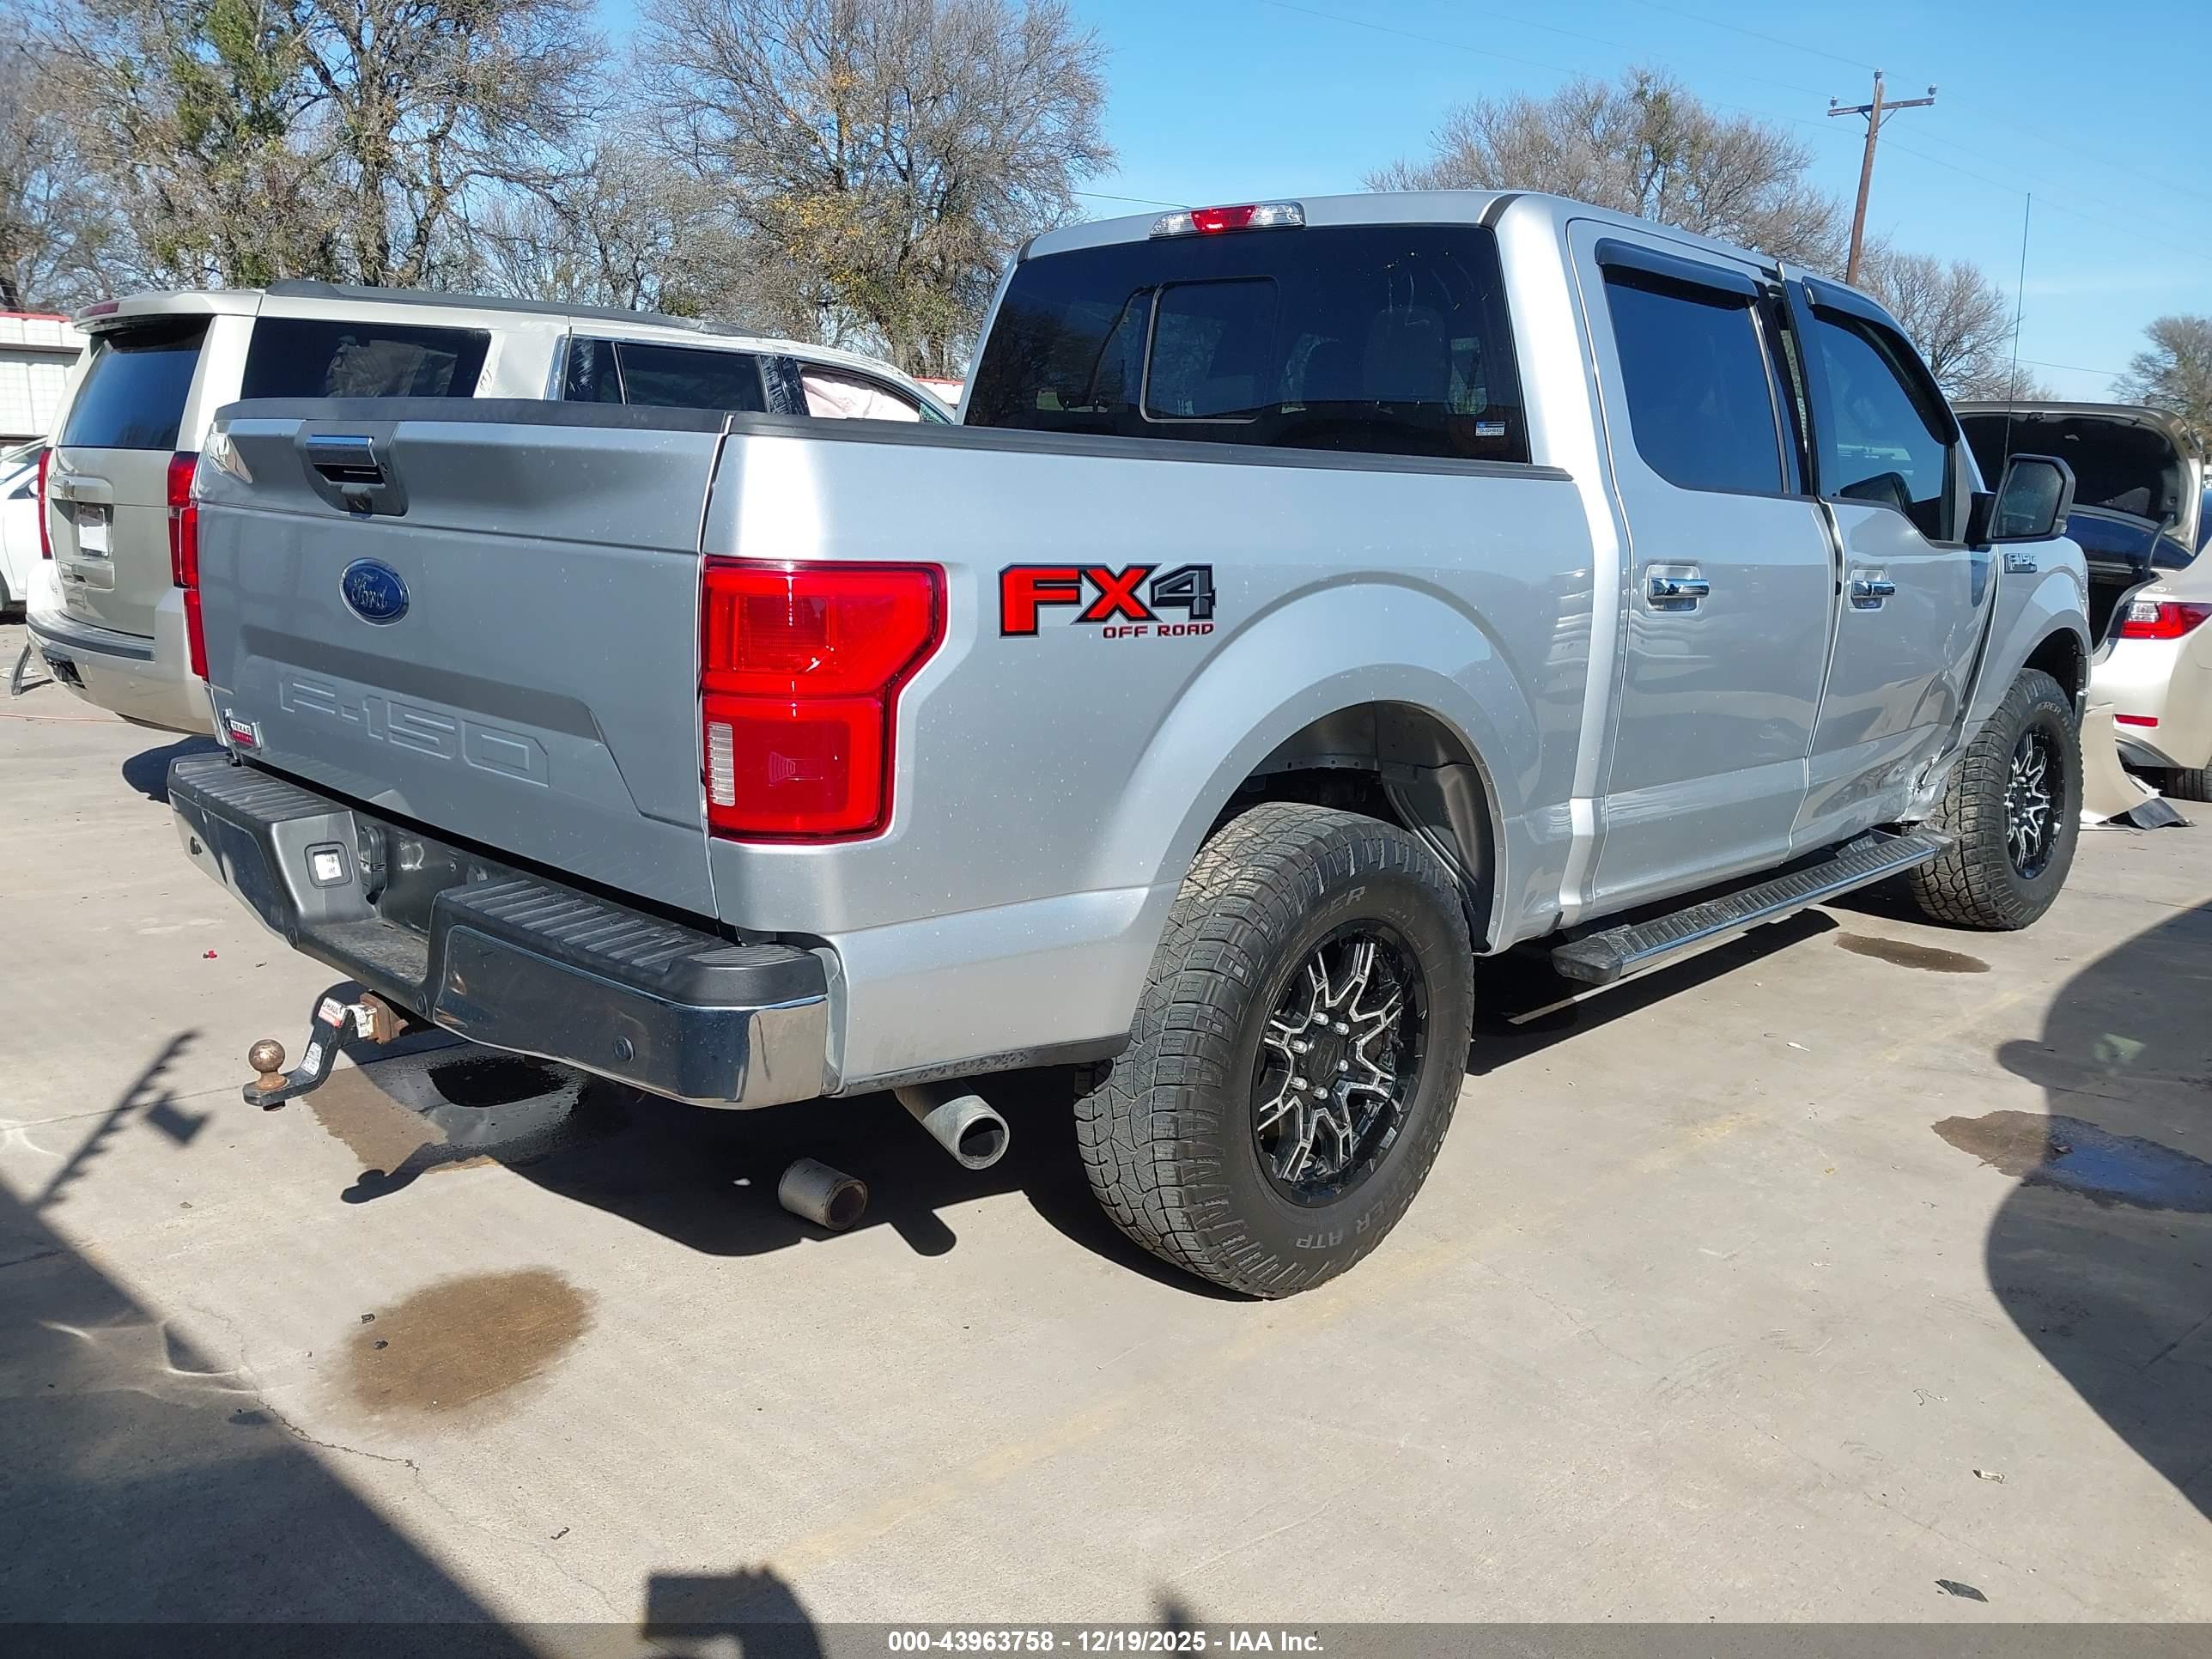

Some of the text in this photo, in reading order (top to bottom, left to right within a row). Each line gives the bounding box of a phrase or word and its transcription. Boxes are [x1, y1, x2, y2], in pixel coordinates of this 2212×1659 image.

[351, 571, 388, 610] Ford
[998, 562, 1217, 639] FX4
[1103, 623, 1214, 639] OFF ROAD
[232, 722, 252, 734] TEXAS
[279, 672, 550, 788] F-150
[1295, 1230, 1344, 1249] ATP
